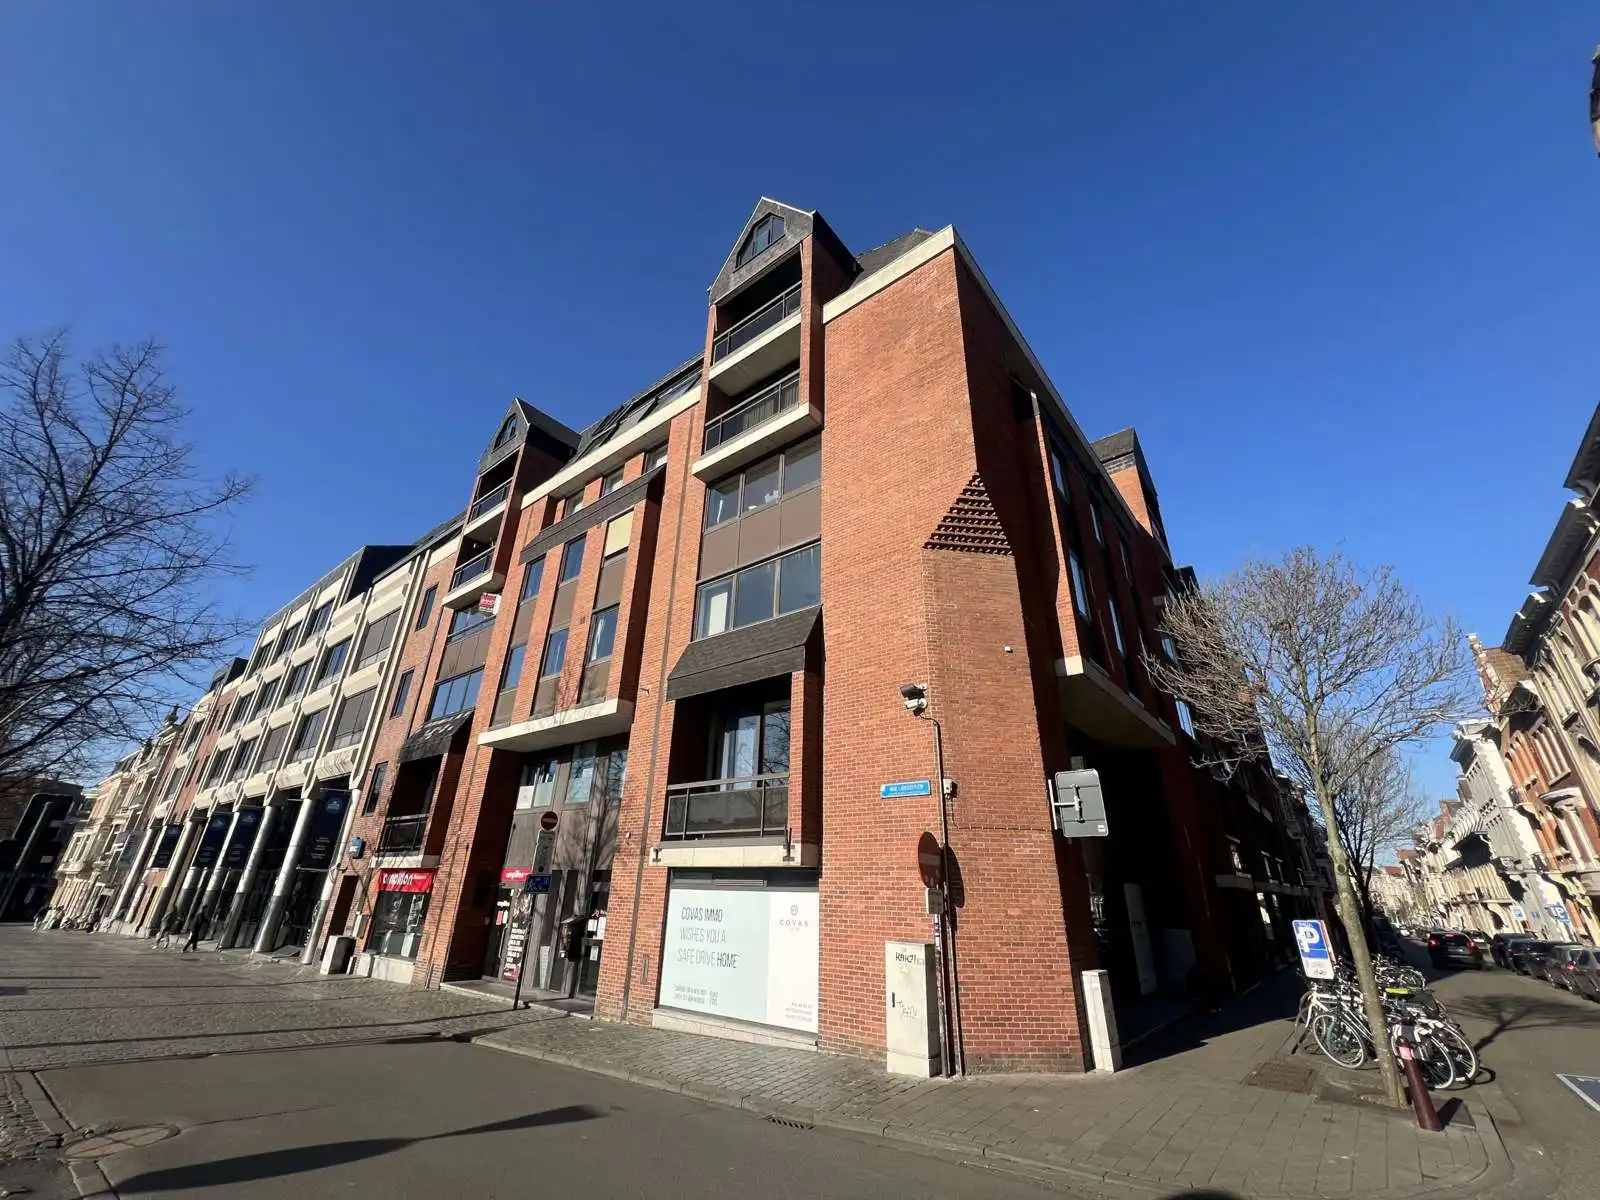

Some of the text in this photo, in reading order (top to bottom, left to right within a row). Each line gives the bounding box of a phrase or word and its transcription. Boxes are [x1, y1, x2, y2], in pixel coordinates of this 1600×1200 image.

[681, 907, 723, 923] COVAS IMMO
[779, 919, 809, 928] COVAS
[680, 927, 727, 944] WISHES YOU A
[1299, 926, 1319, 952] P
[677, 948, 738, 968] SAFE DRIVE HOME
